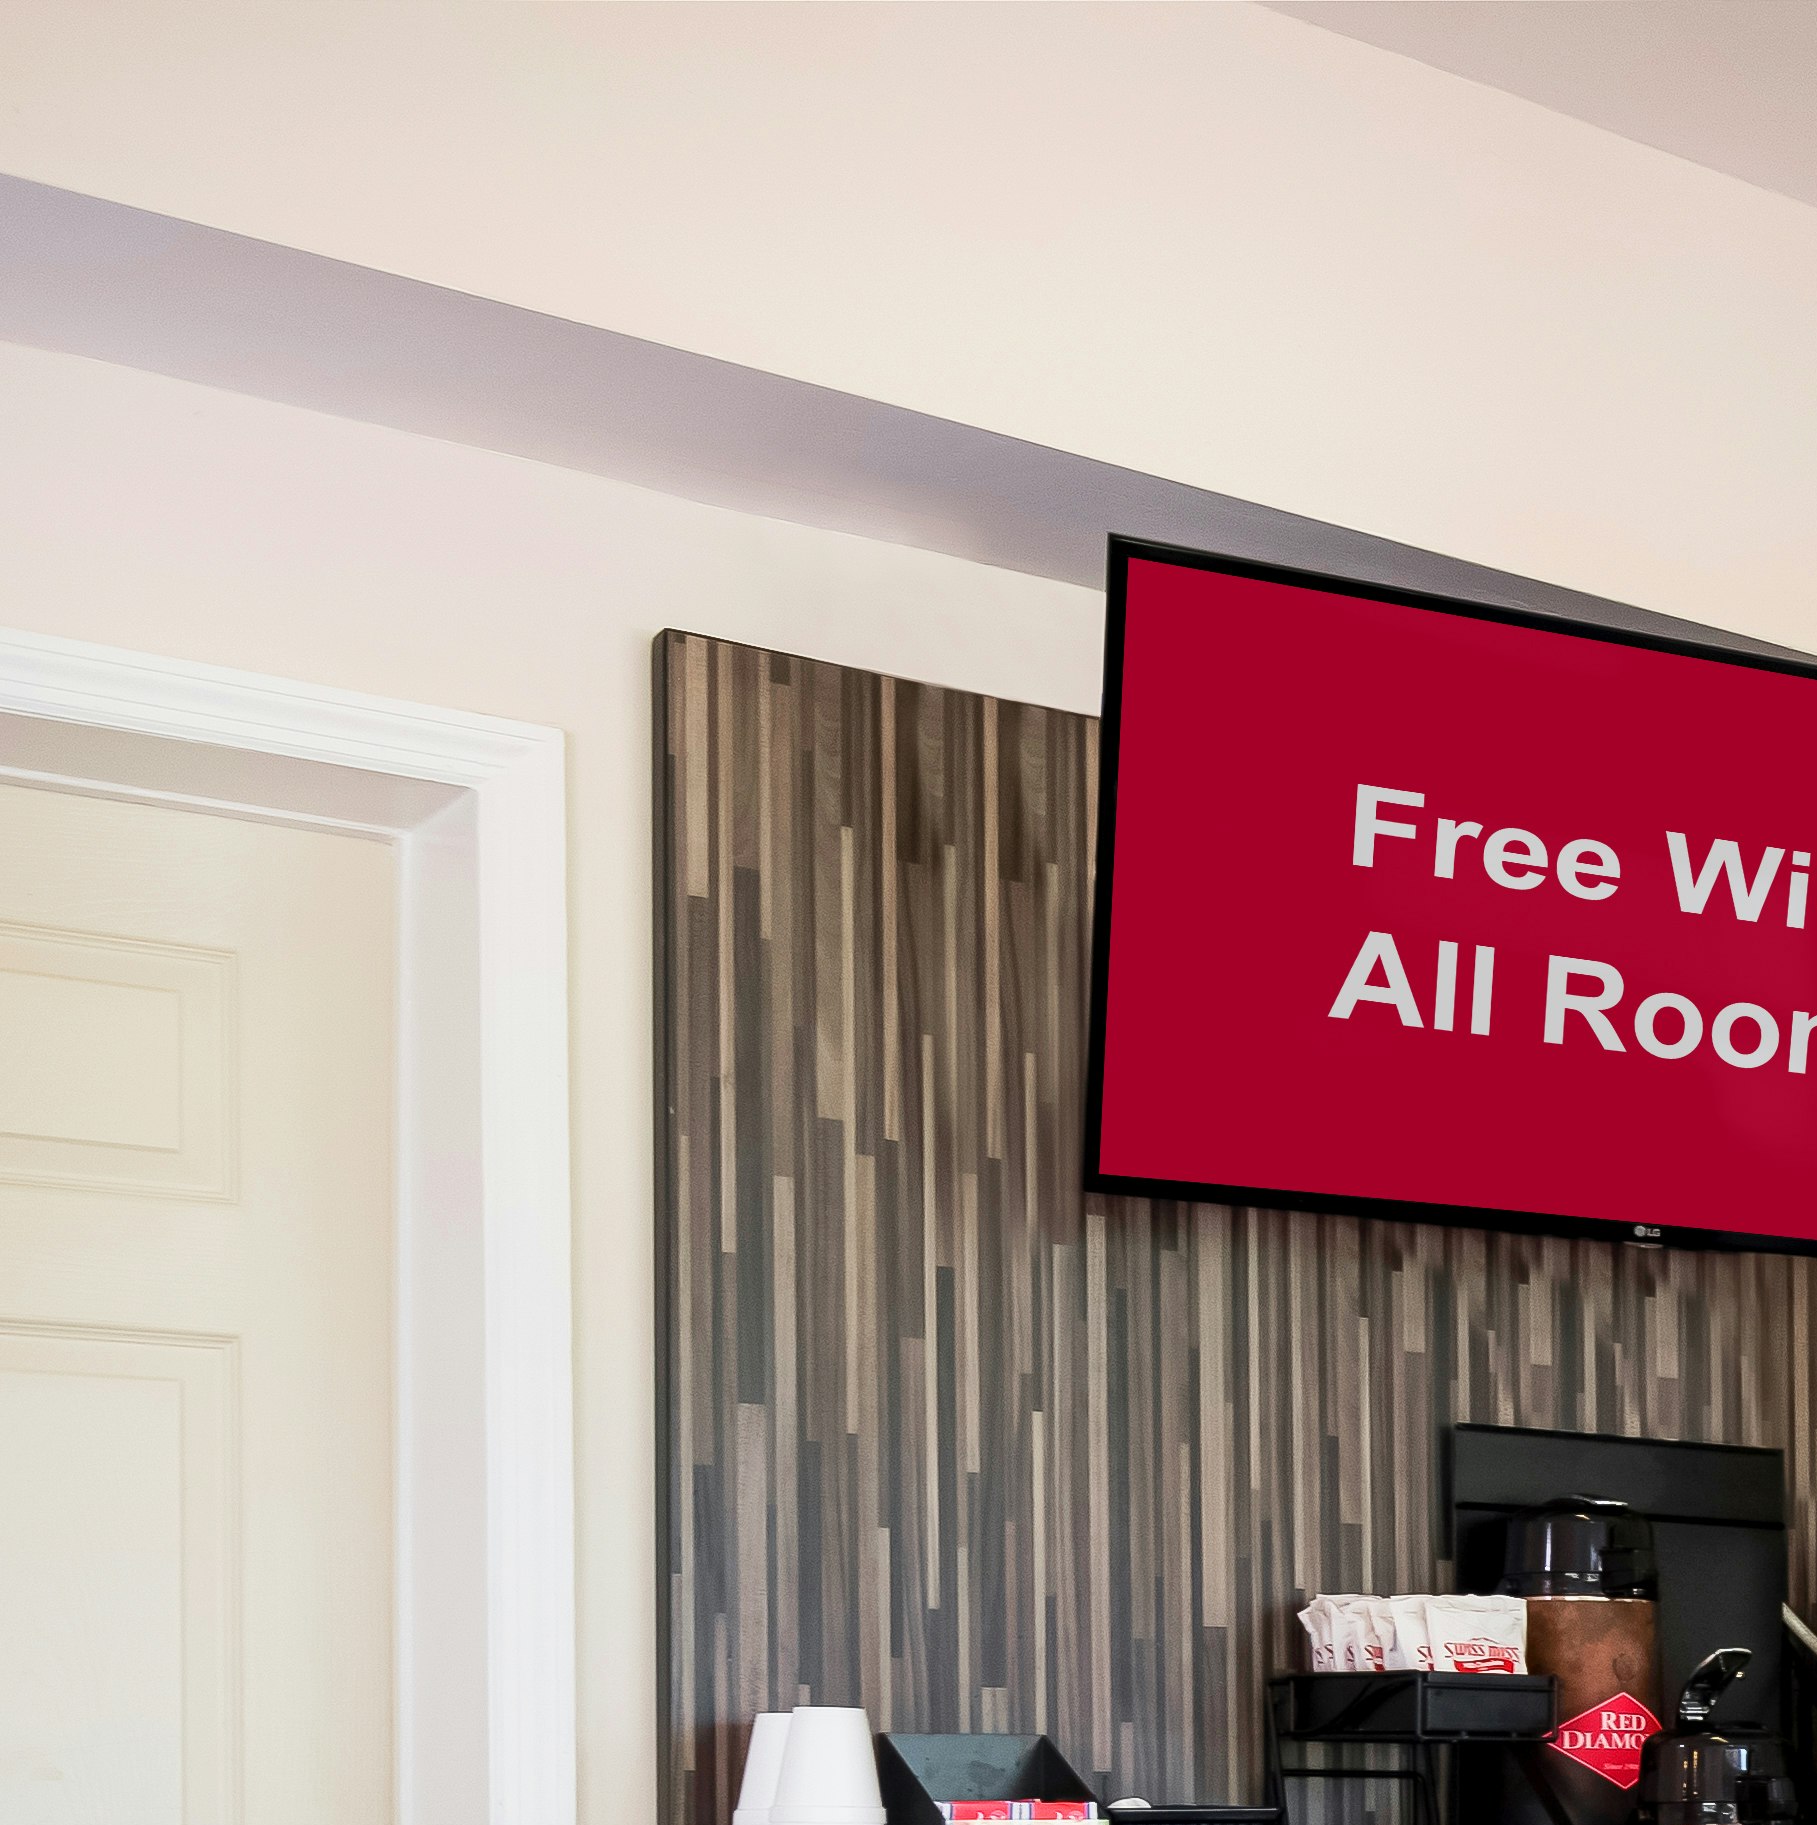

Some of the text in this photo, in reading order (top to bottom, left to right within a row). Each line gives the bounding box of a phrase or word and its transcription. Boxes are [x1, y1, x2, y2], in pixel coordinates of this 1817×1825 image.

[1352, 783, 1621, 901] Free
[1327, 930, 1495, 1036] All
[1562, 1730, 1649, 1750] DIAMO
[1600, 1711, 1647, 1732] RED
